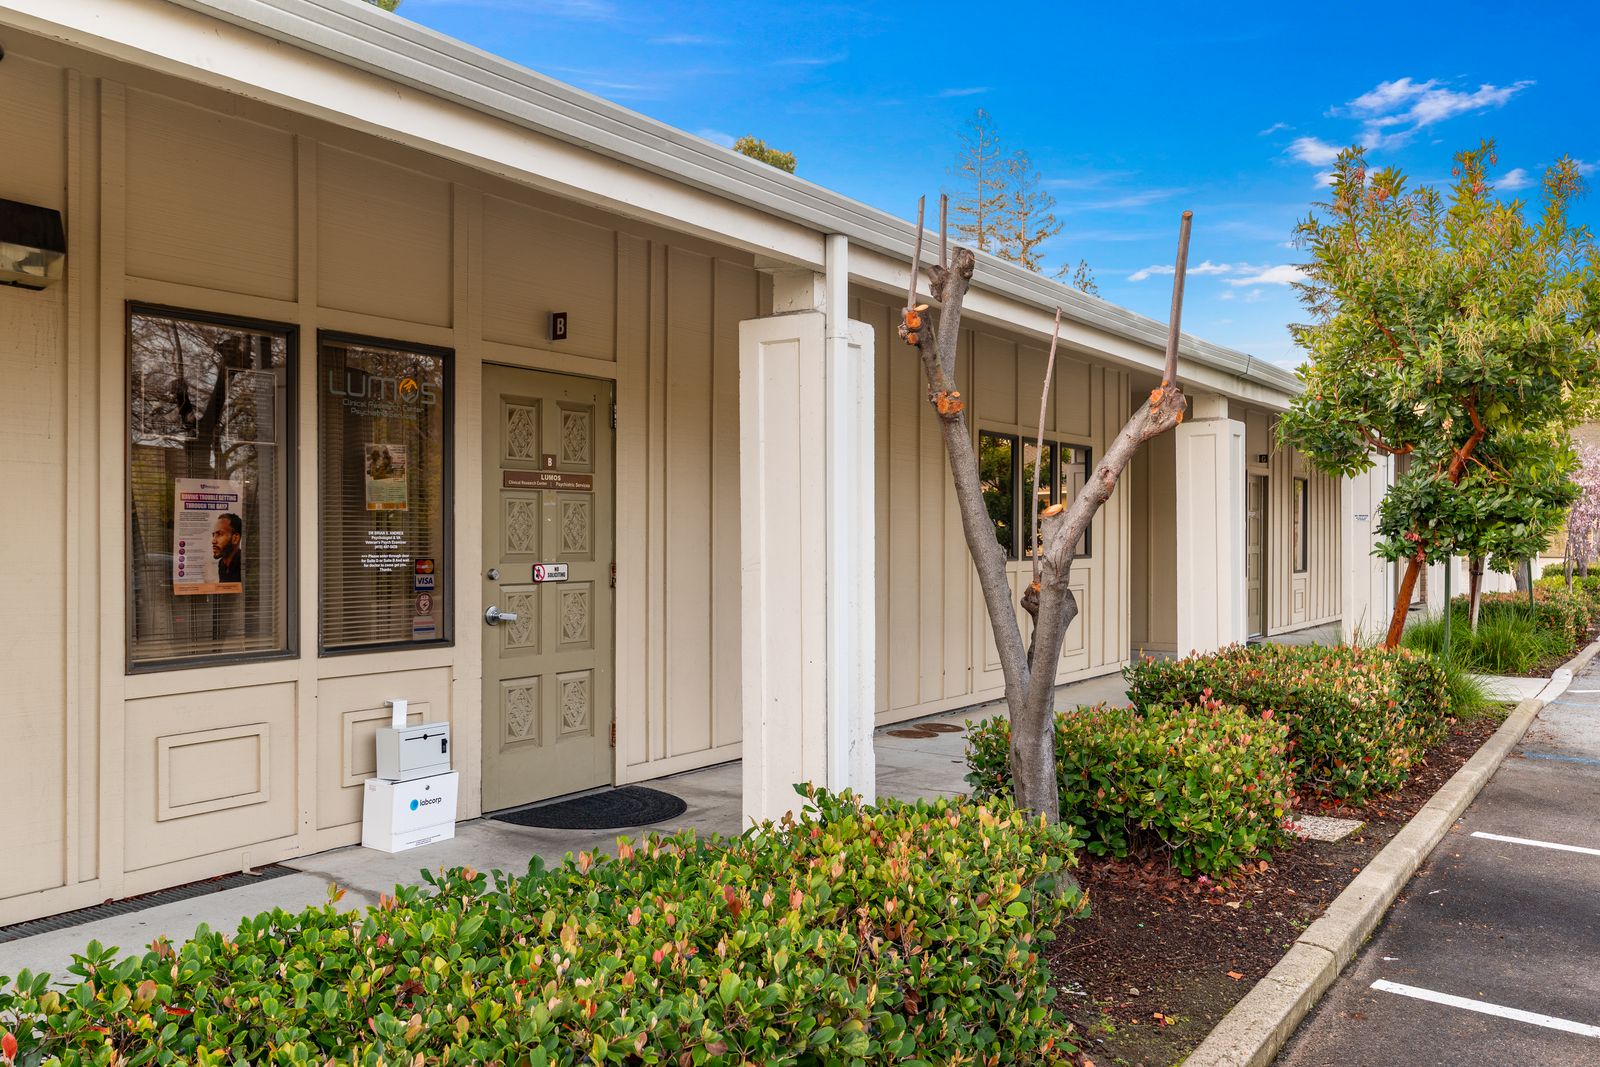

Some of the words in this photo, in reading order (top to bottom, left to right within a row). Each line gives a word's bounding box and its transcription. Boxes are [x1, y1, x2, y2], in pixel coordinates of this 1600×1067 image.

[557, 318, 564, 334] B
[548, 458, 552, 466] B
[420, 797, 441, 806] labcorp
